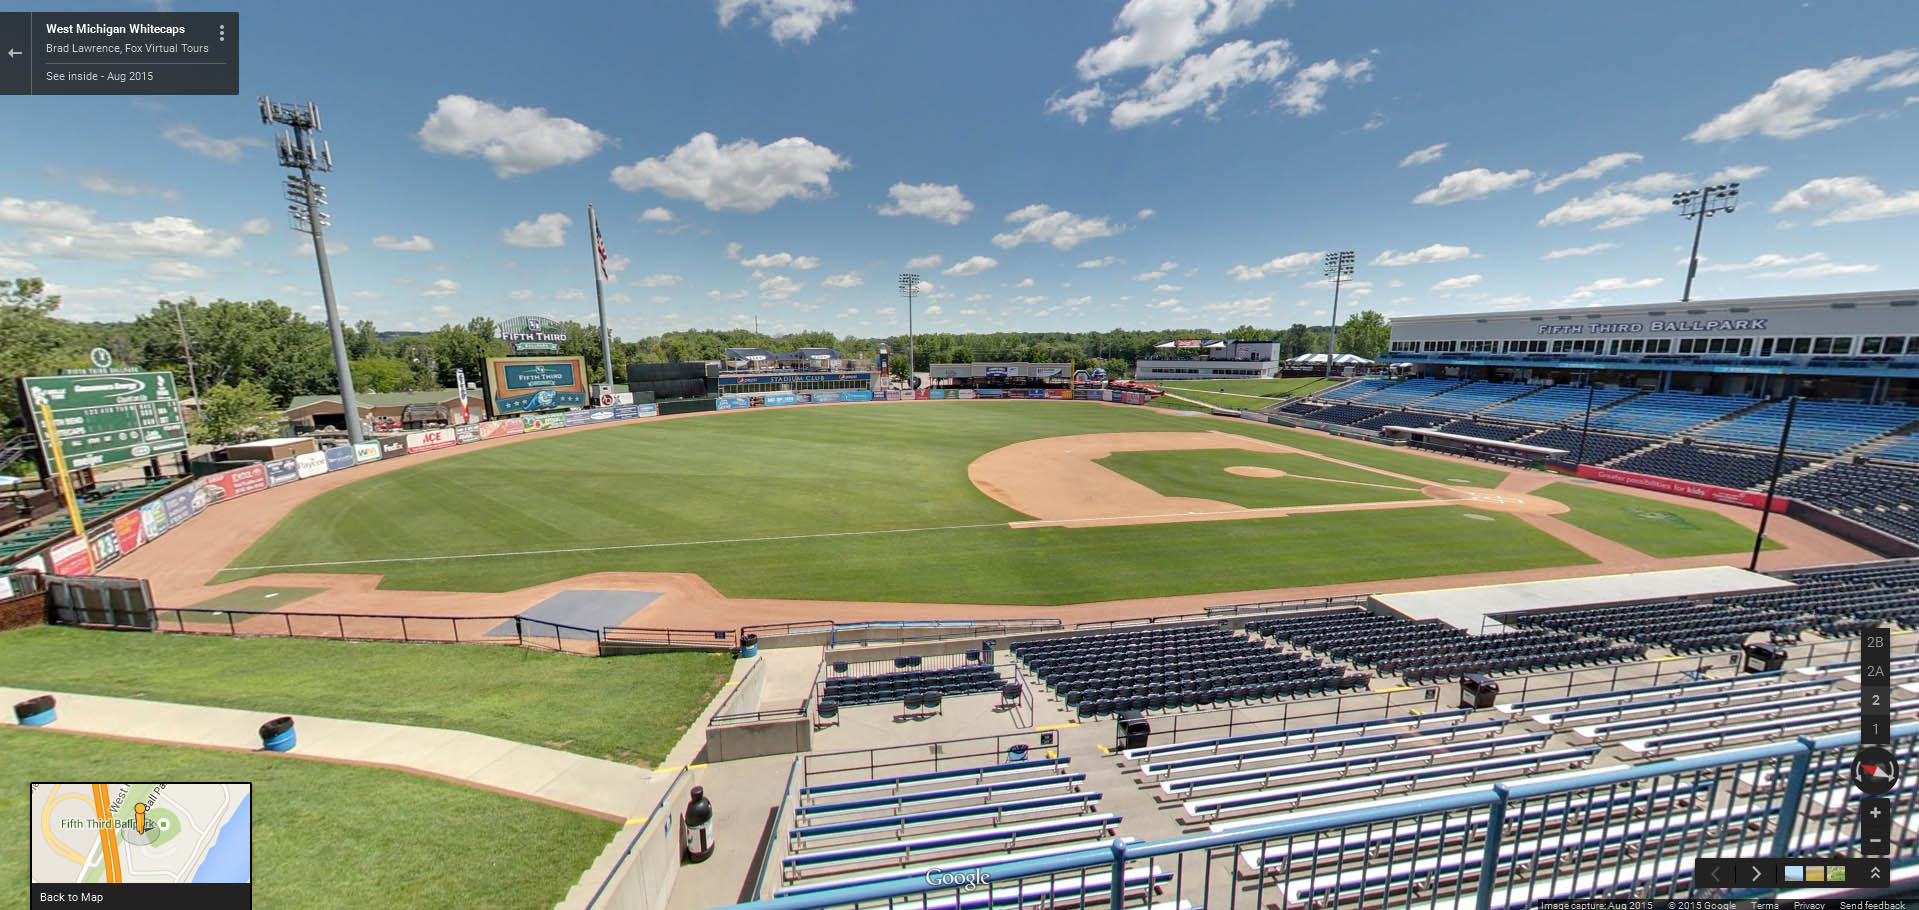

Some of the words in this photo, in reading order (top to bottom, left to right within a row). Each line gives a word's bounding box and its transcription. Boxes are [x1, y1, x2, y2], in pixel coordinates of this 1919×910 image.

[1538, 325, 1582, 334] FIFTH
[1589, 323, 1643, 333] THIRD
[1651, 318, 1768, 332] BALLPARK
[502, 332, 534, 341] FIFTH
[535, 332, 567, 341] THIRD
[423, 433, 441, 444] ACE
[383, 442, 404, 452] FedEx
